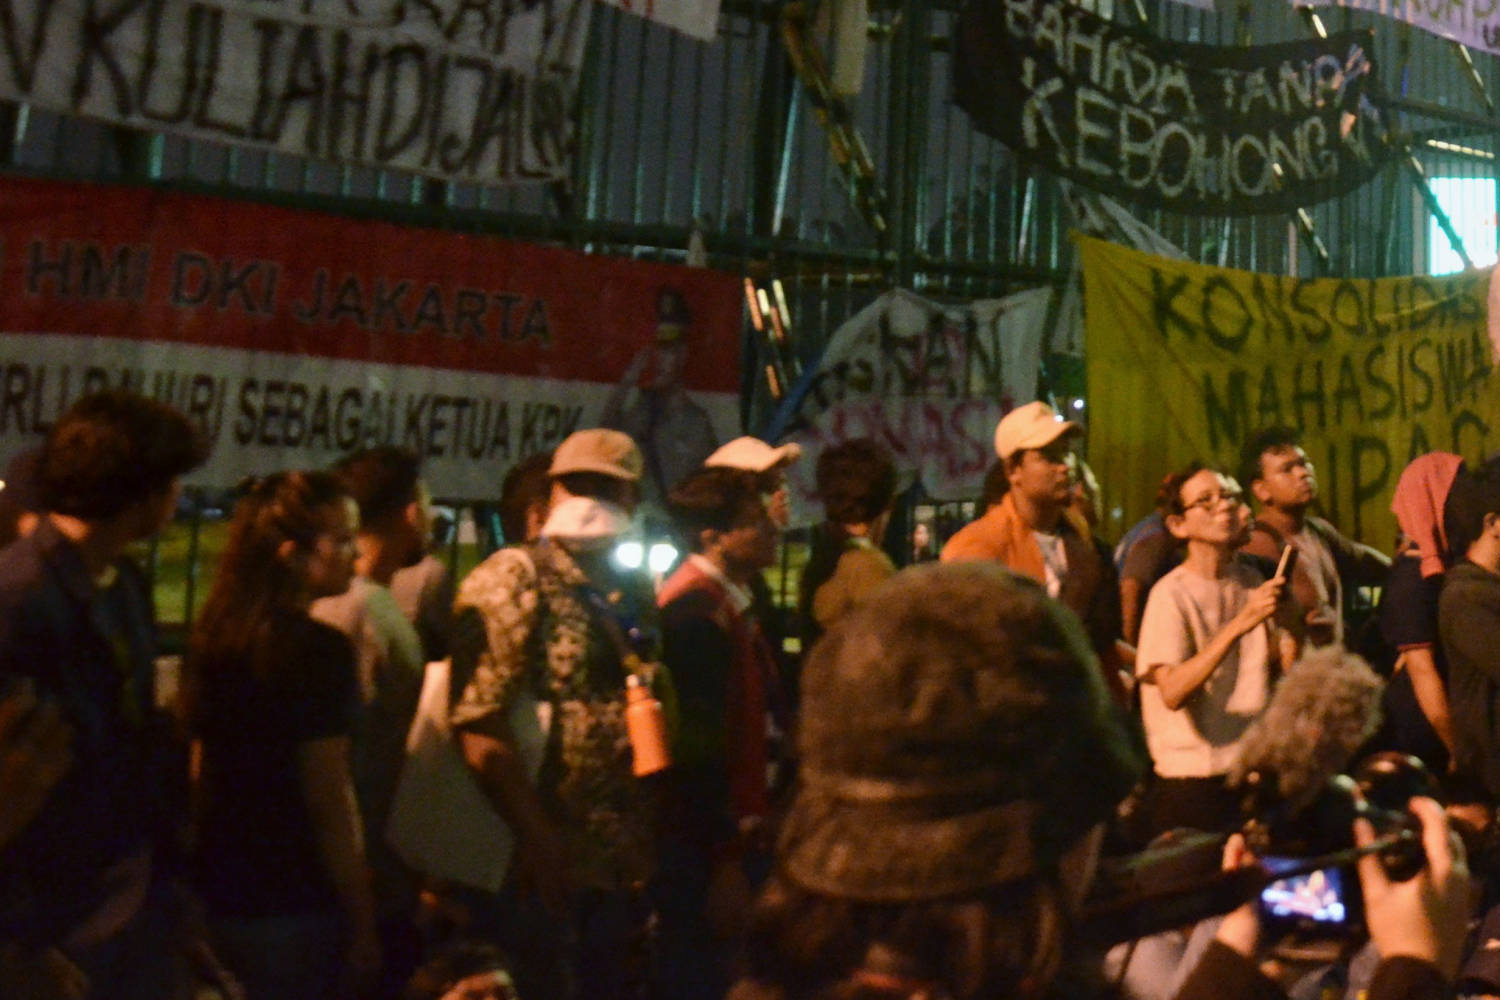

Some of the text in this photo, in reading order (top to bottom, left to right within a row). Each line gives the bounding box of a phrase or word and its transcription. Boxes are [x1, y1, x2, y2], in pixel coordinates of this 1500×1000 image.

[292, 263, 559, 351] JAKARTA
[233, 376, 398, 458] SEBAGAI
[402, 389, 510, 463] KETUA
